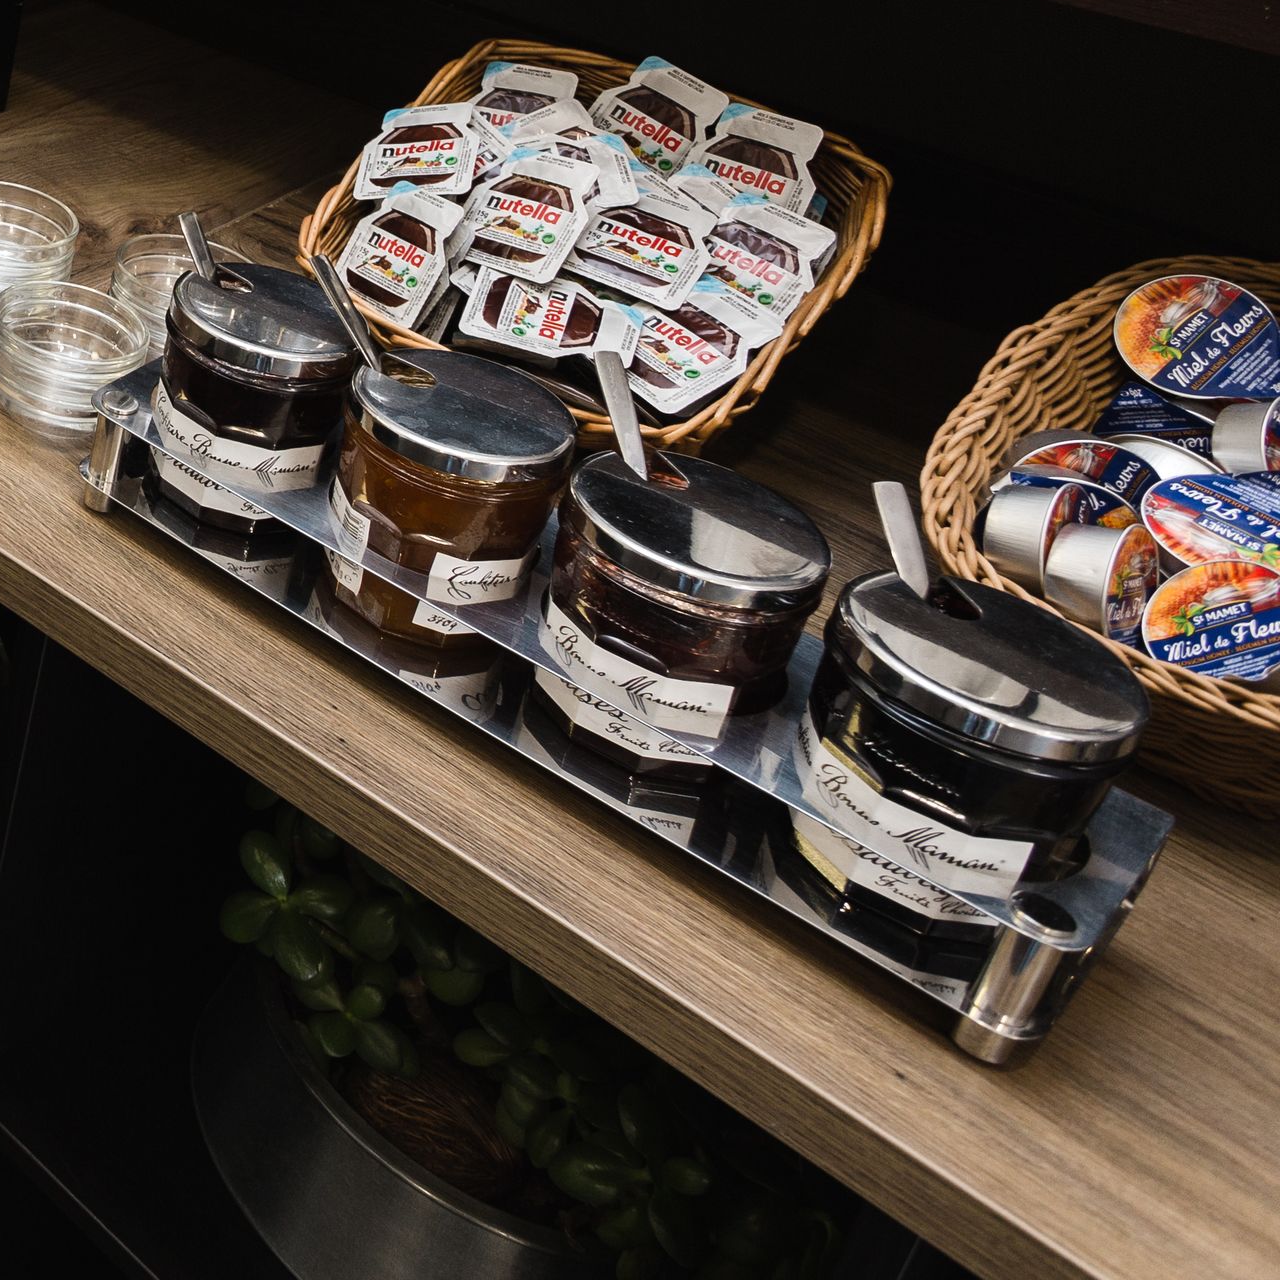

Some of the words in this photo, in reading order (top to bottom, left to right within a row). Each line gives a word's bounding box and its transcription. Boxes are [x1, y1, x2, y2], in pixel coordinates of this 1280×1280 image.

[610, 104, 683, 153] nutella
[381, 139, 455, 158] nutella
[704, 158, 786, 196] nutella
[486, 195, 561, 225] nutella
[367, 231, 425, 268] nutella
[596, 220, 682, 258] nutella
[538, 290, 569, 341] nutella
[1180, 311, 1209, 342] MAMET
[1210, 305, 1264, 348] Fleurs
[643, 315, 719, 365] nutella
[1207, 347, 1222, 360] de
[1166, 351, 1209, 388] Miel
[244, 455, 310, 488] Maman
[1104, 461, 1141, 493] leurs
[1169, 482, 1242, 521] Fleurs
[1198, 518, 1247, 544] MAMET
[427, 613, 458, 631] 370g
[1205, 602, 1248, 622] MAMET
[1163, 633, 1212, 662] Miel
[1213, 635, 1231, 649] de
[1230, 619, 1280, 644] Fleu
[611, 675, 708, 716] Maman
[604, 721, 651, 751] Fruits
[886, 826, 1000, 871] Maman
[874, 874, 931, 909] Fruits
